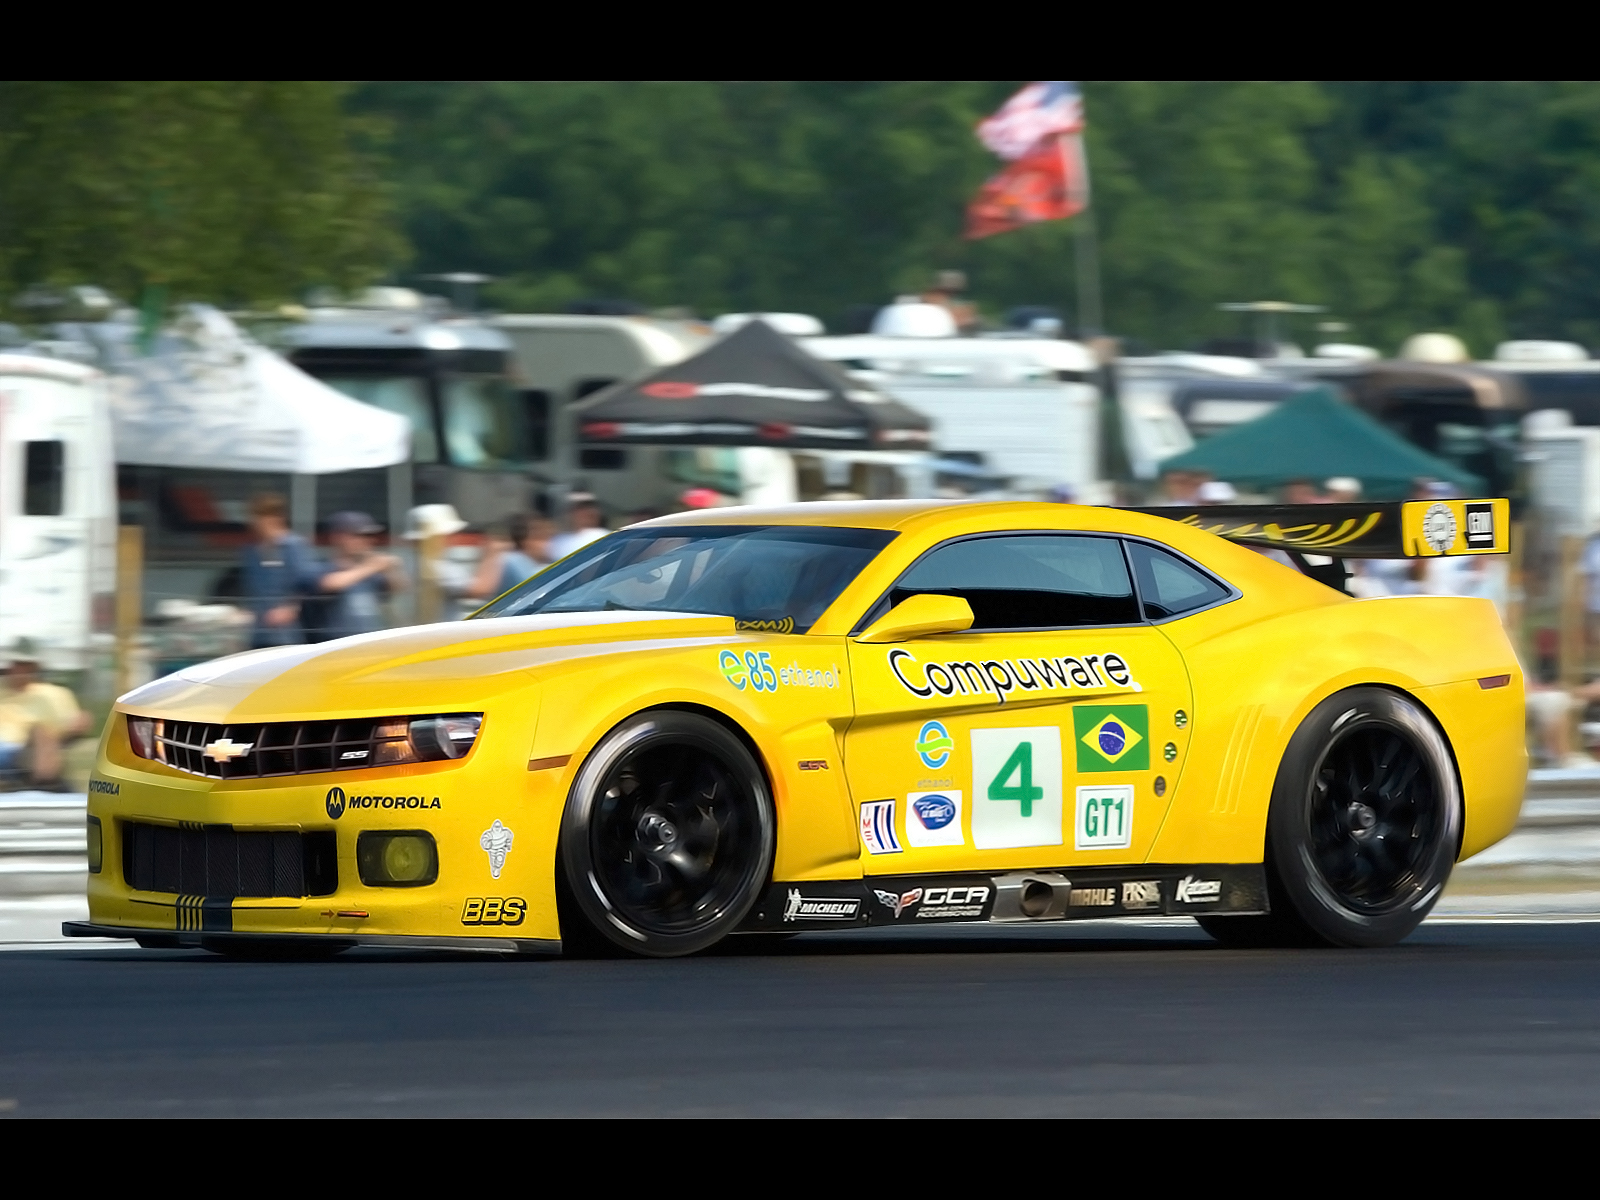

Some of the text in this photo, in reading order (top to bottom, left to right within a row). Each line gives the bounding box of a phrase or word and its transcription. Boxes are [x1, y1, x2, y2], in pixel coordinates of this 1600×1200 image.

[780, 661, 840, 688] ethanol
[889, 649, 1130, 706] Compuware
[89, 780, 120, 796] OTOROLA
[987, 741, 1043, 817] 4
[348, 796, 442, 809] MOTOROLA
[1085, 797, 1124, 838] GT1
[800, 903, 857, 914] MICHELIN
[923, 887, 990, 904] GCA
[461, 897, 527, 926] BBS
